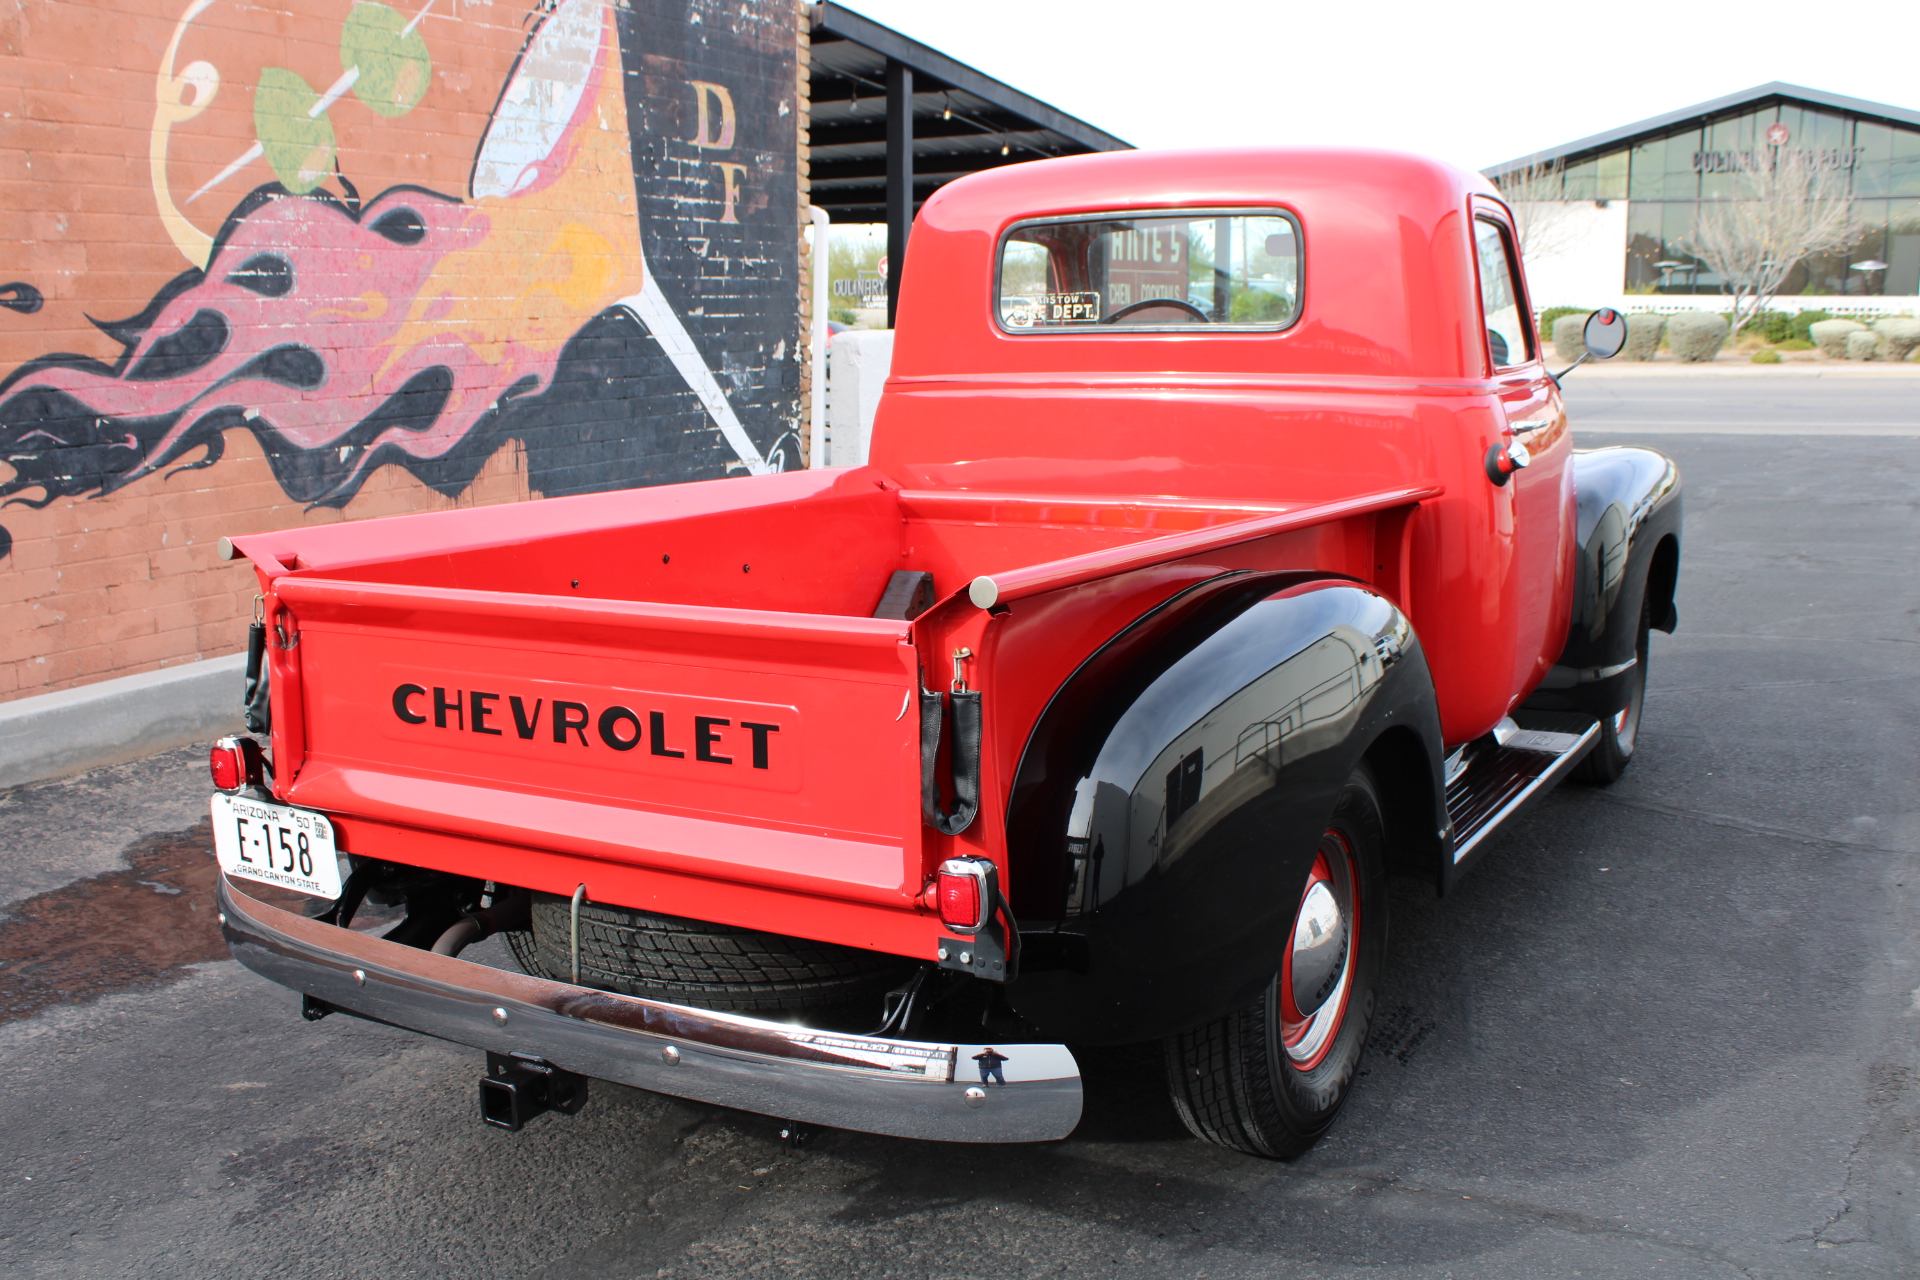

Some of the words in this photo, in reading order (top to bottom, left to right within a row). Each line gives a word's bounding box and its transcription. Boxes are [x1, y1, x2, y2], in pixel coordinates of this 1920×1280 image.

[687, 80, 736, 150] D
[716, 161, 748, 224] F
[833, 279, 886, 297] CULINARY
[1053, 304, 1095, 319] DEPT.
[392, 683, 780, 770] CHEVROLET
[232, 803, 280, 822] ARIZONA
[296, 816, 310, 829] 50
[236, 864, 263, 877] GRAND
[264, 870, 295, 885] CANYON
[297, 878, 320, 891] STATE
